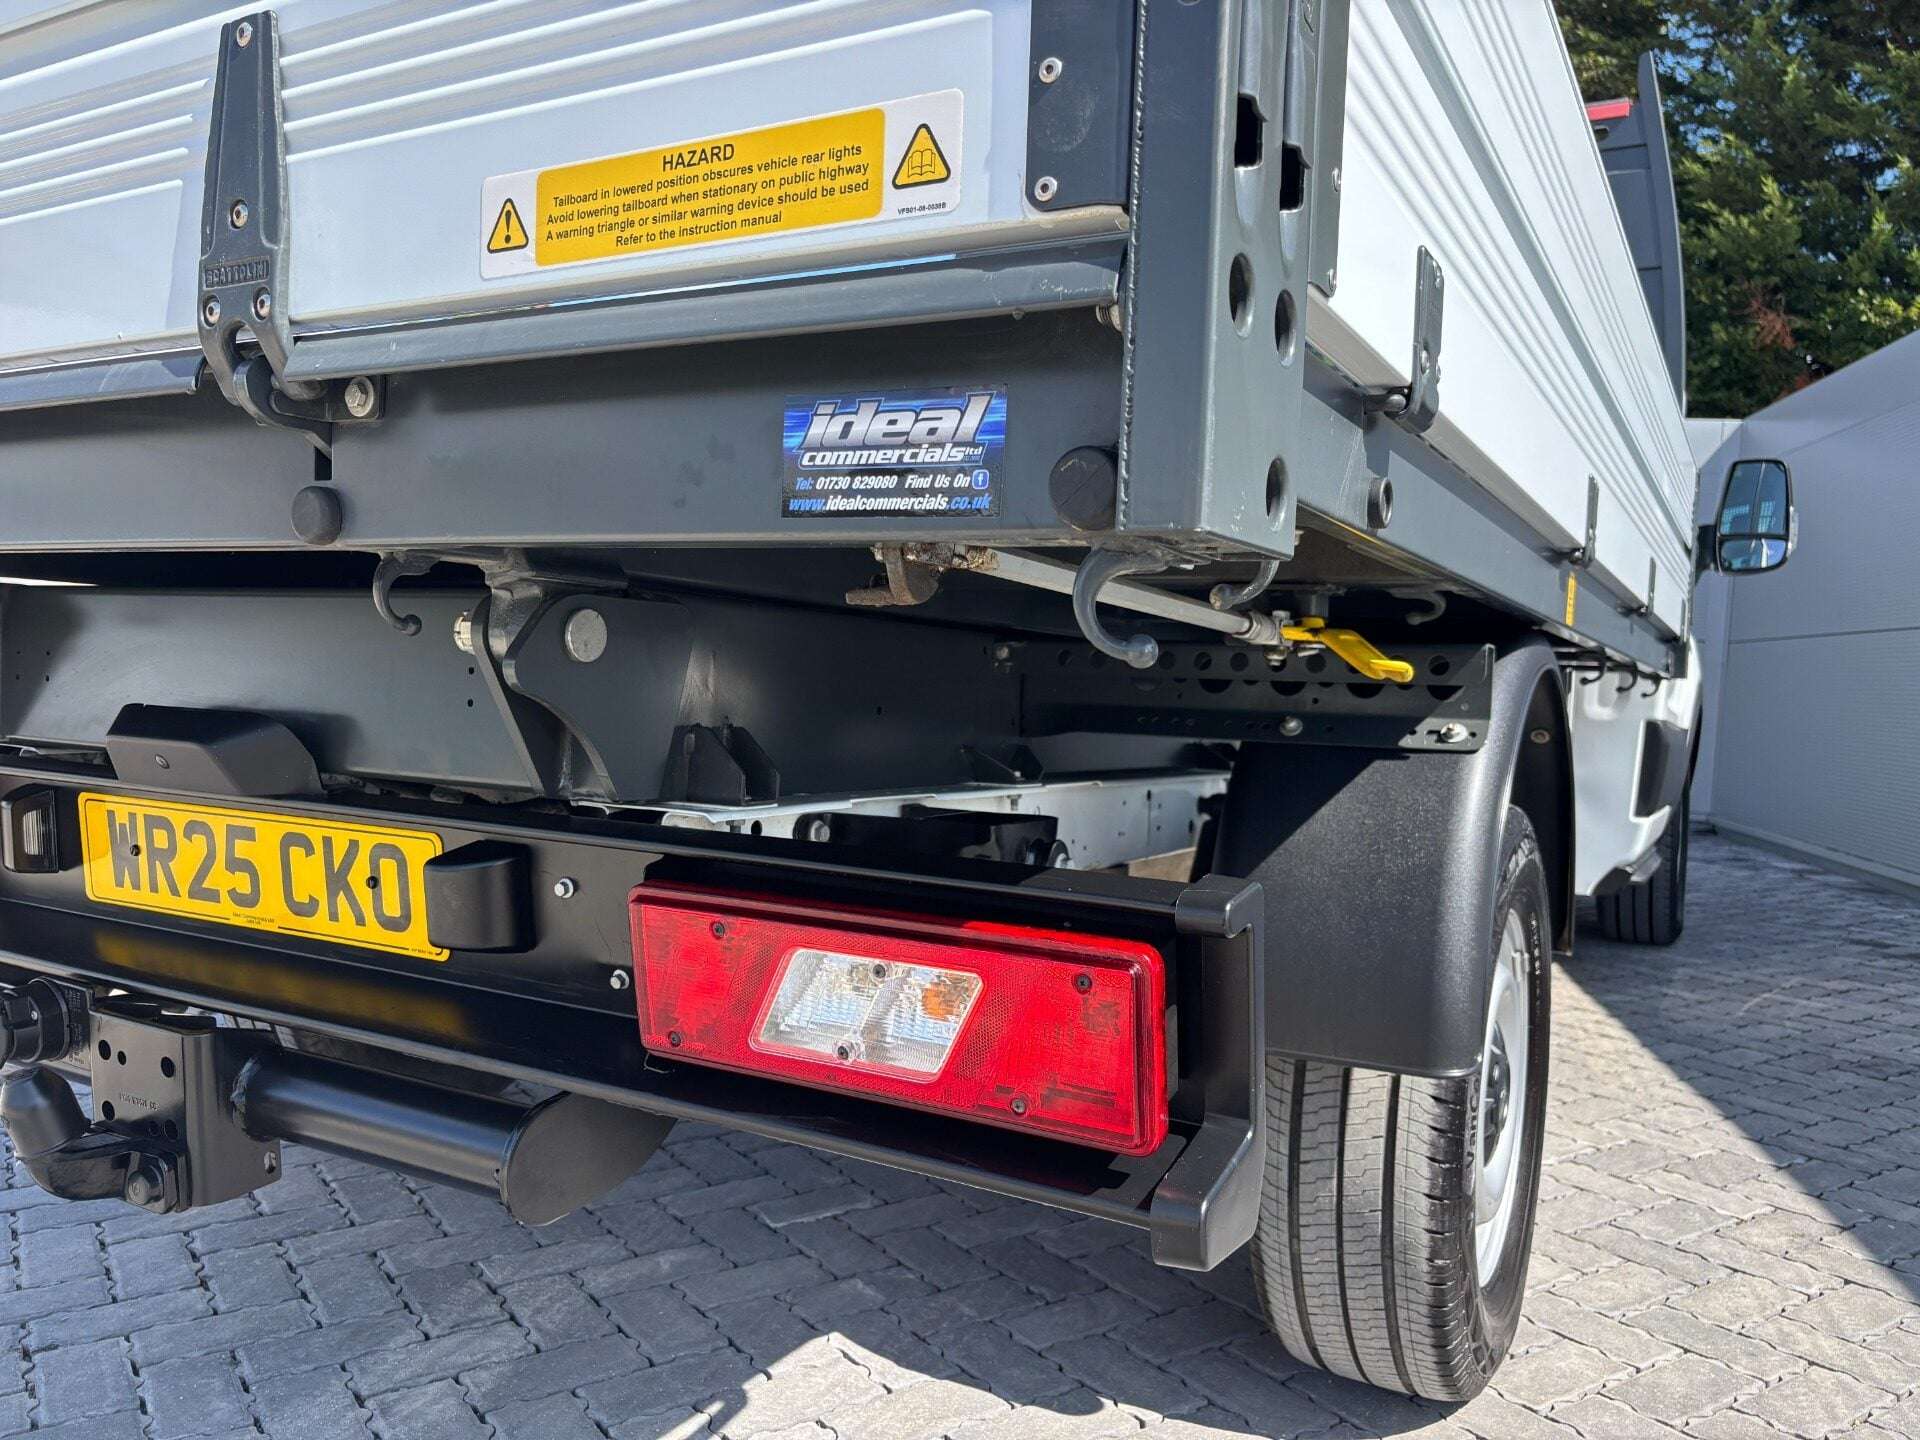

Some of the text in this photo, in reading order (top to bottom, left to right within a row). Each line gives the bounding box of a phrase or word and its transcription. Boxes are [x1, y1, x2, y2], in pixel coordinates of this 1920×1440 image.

[553, 144, 862, 208] Tailboard in lowered position obscures vehicle rear lights
[662, 143, 735, 172] HAZARD
[546, 162, 869, 225] Avoid lowering tailboard when stationary on public highway
[546, 179, 869, 242] A warning triangle or similar warning device should be used
[616, 211, 782, 247] Refer to the instruction manual
[799, 392, 994, 449] ideal
[801, 443, 983, 466] commercials ltd
[788, 493, 992, 512] www.idealcommercials.co.uk
[795, 477, 813, 491] Tel:
[815, 476, 851, 490] 01730
[852, 475, 898, 490] 829080
[904, 474, 931, 489] Find
[934, 474, 950, 489] Us
[953, 473, 971, 488] On
[106, 809, 412, 933] WR25 CKO
